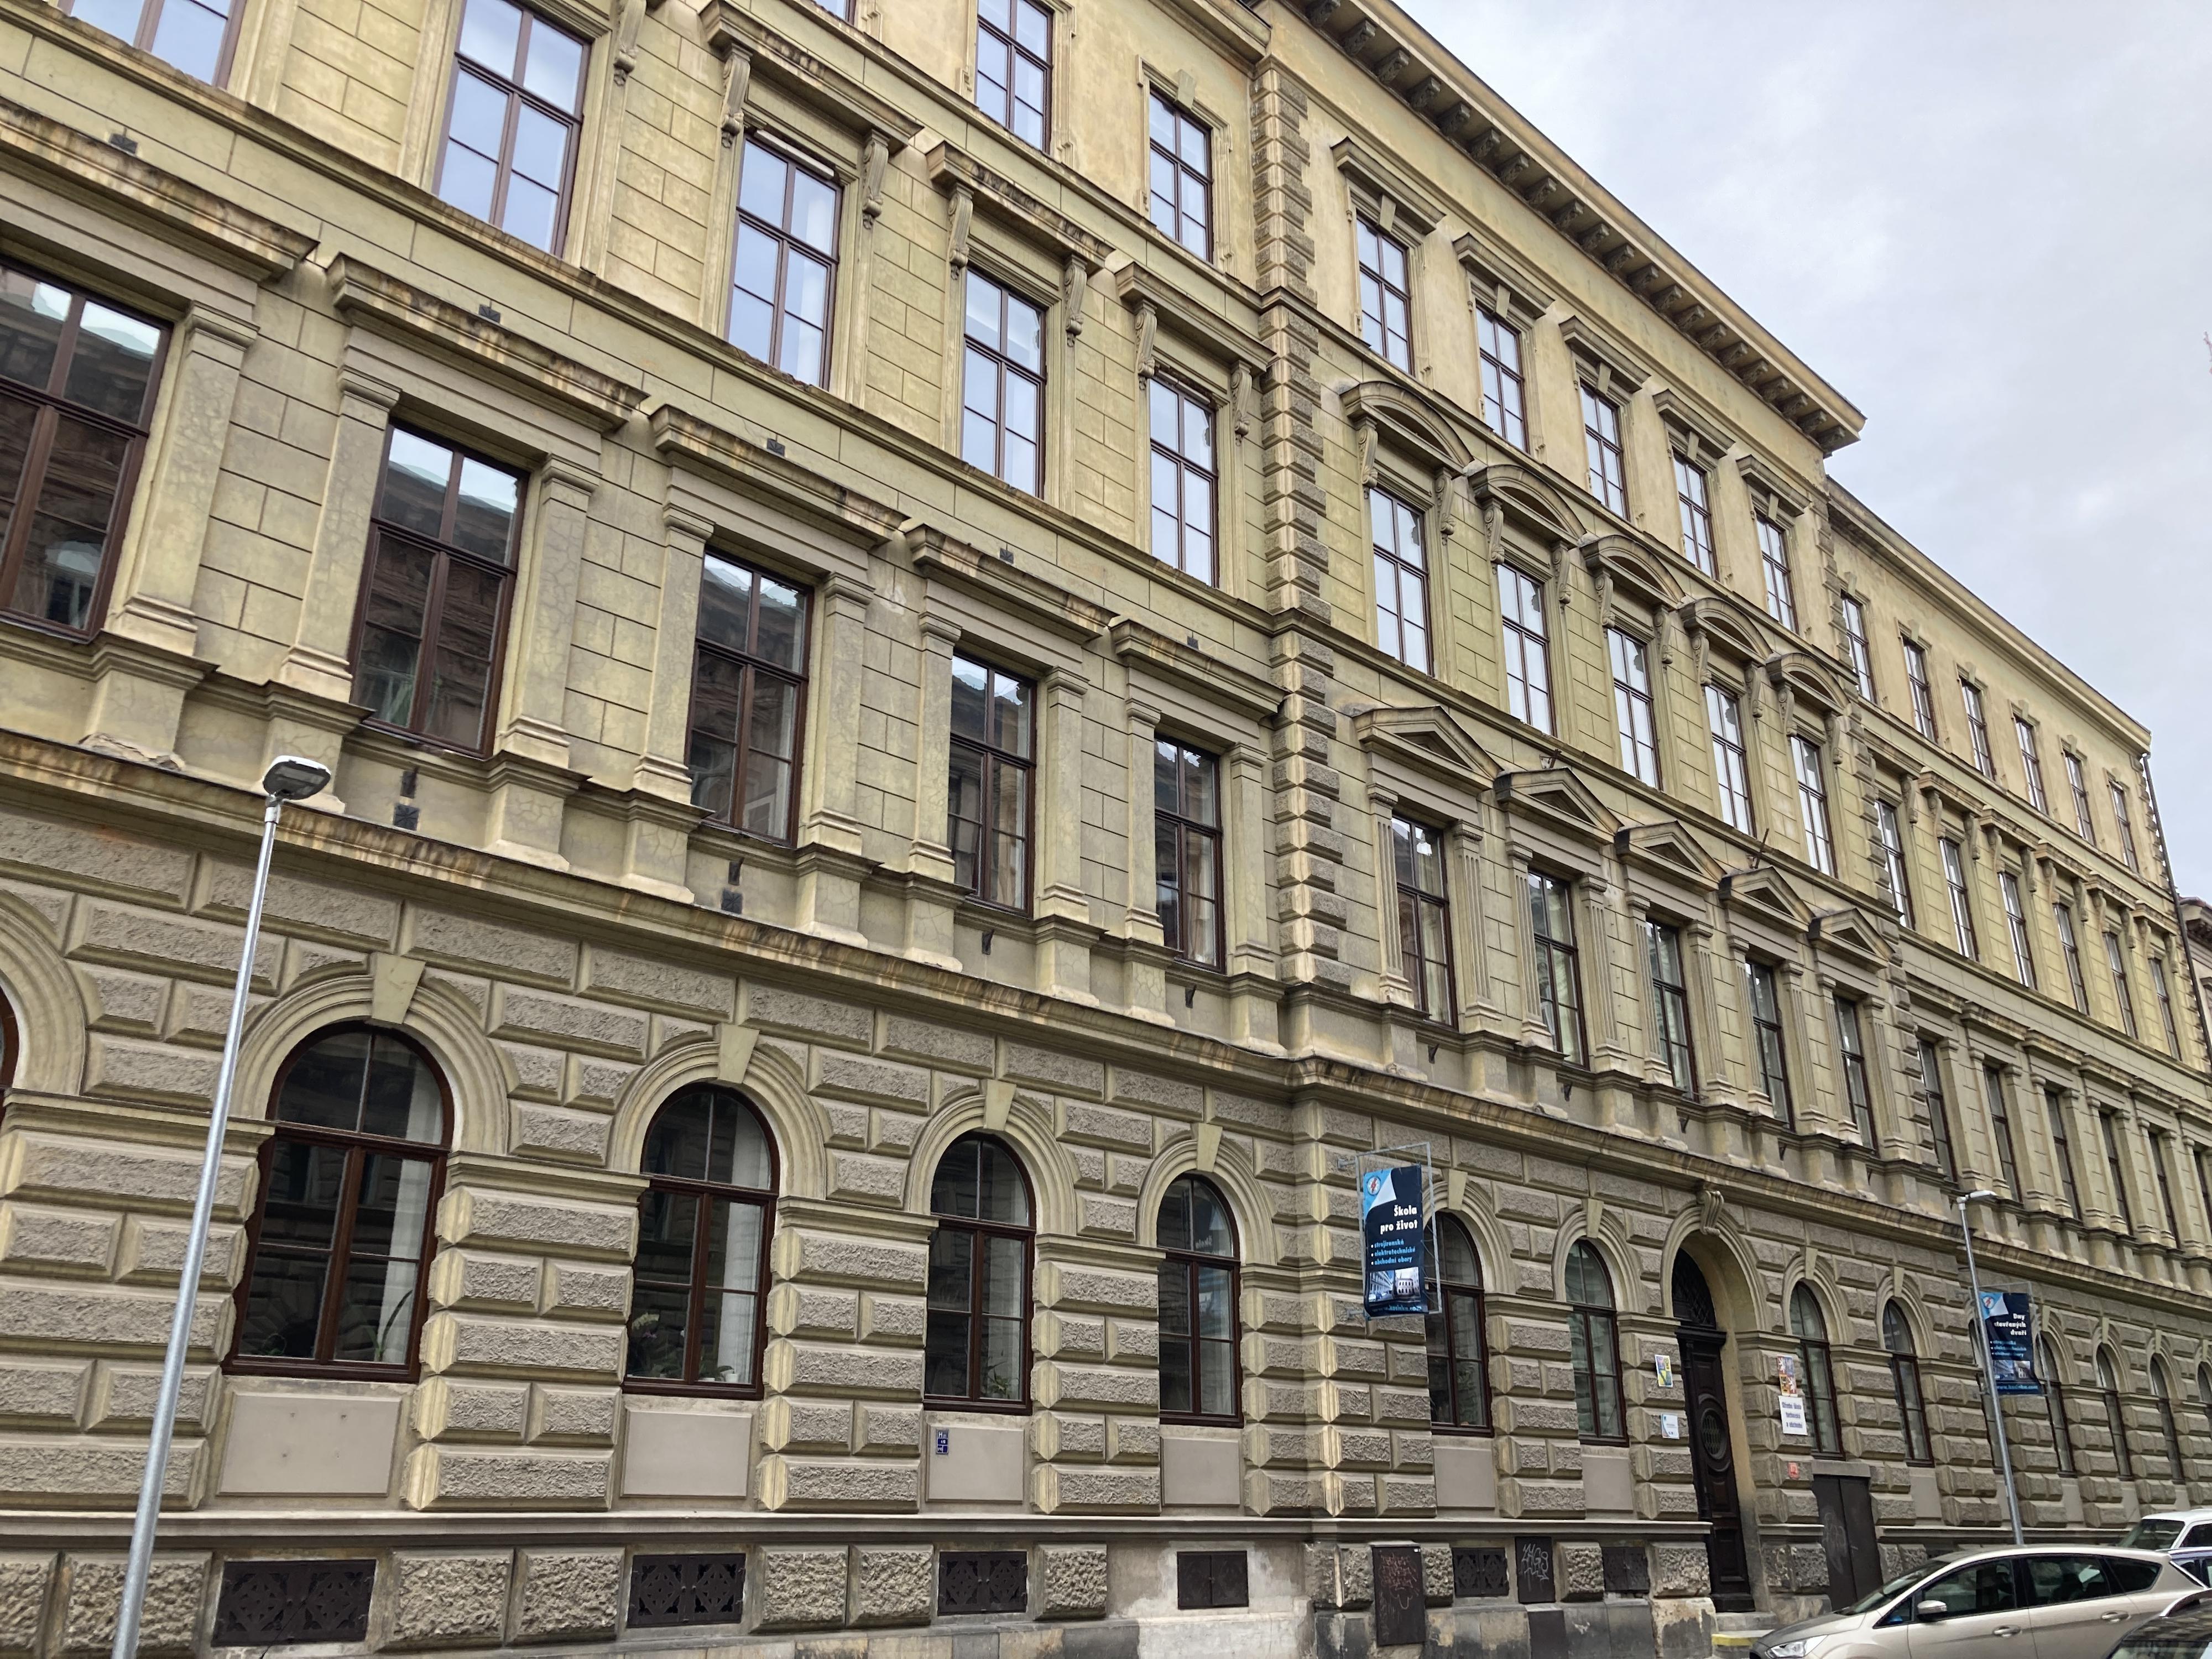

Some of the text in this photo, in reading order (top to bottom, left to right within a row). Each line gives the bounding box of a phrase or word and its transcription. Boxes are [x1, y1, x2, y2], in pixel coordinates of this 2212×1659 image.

[1394, 1204, 1417, 1217] Škola
[1380, 1219, 1418, 1235] pro život
